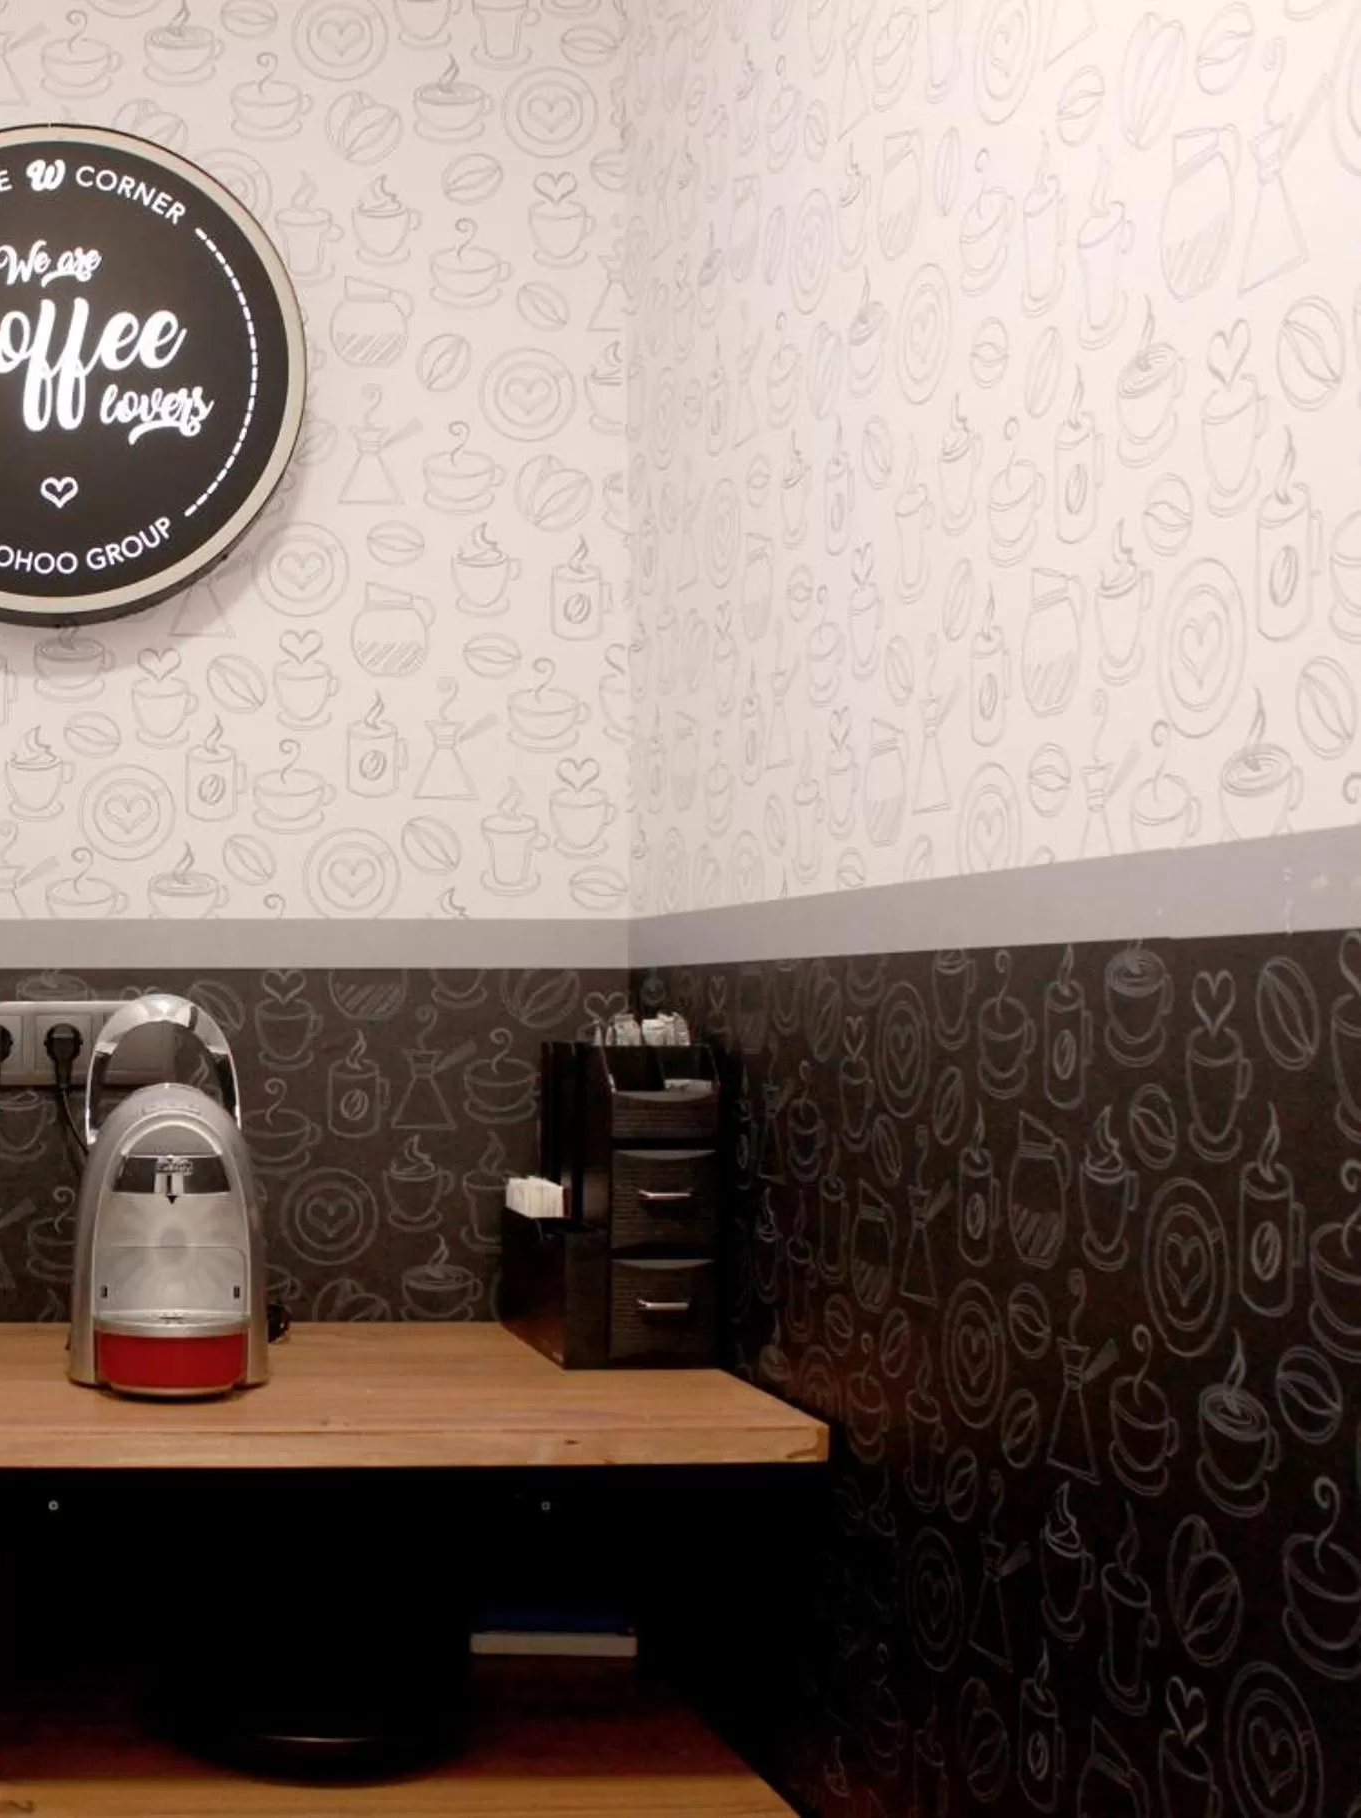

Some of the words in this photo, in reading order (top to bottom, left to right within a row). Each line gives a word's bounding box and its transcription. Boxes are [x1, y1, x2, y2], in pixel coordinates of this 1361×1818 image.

[75, 165, 187, 226] CORNER
[42, 246, 103, 288] are
[99, 384, 215, 446] lovers
[85, 515, 173, 572] GROUP
